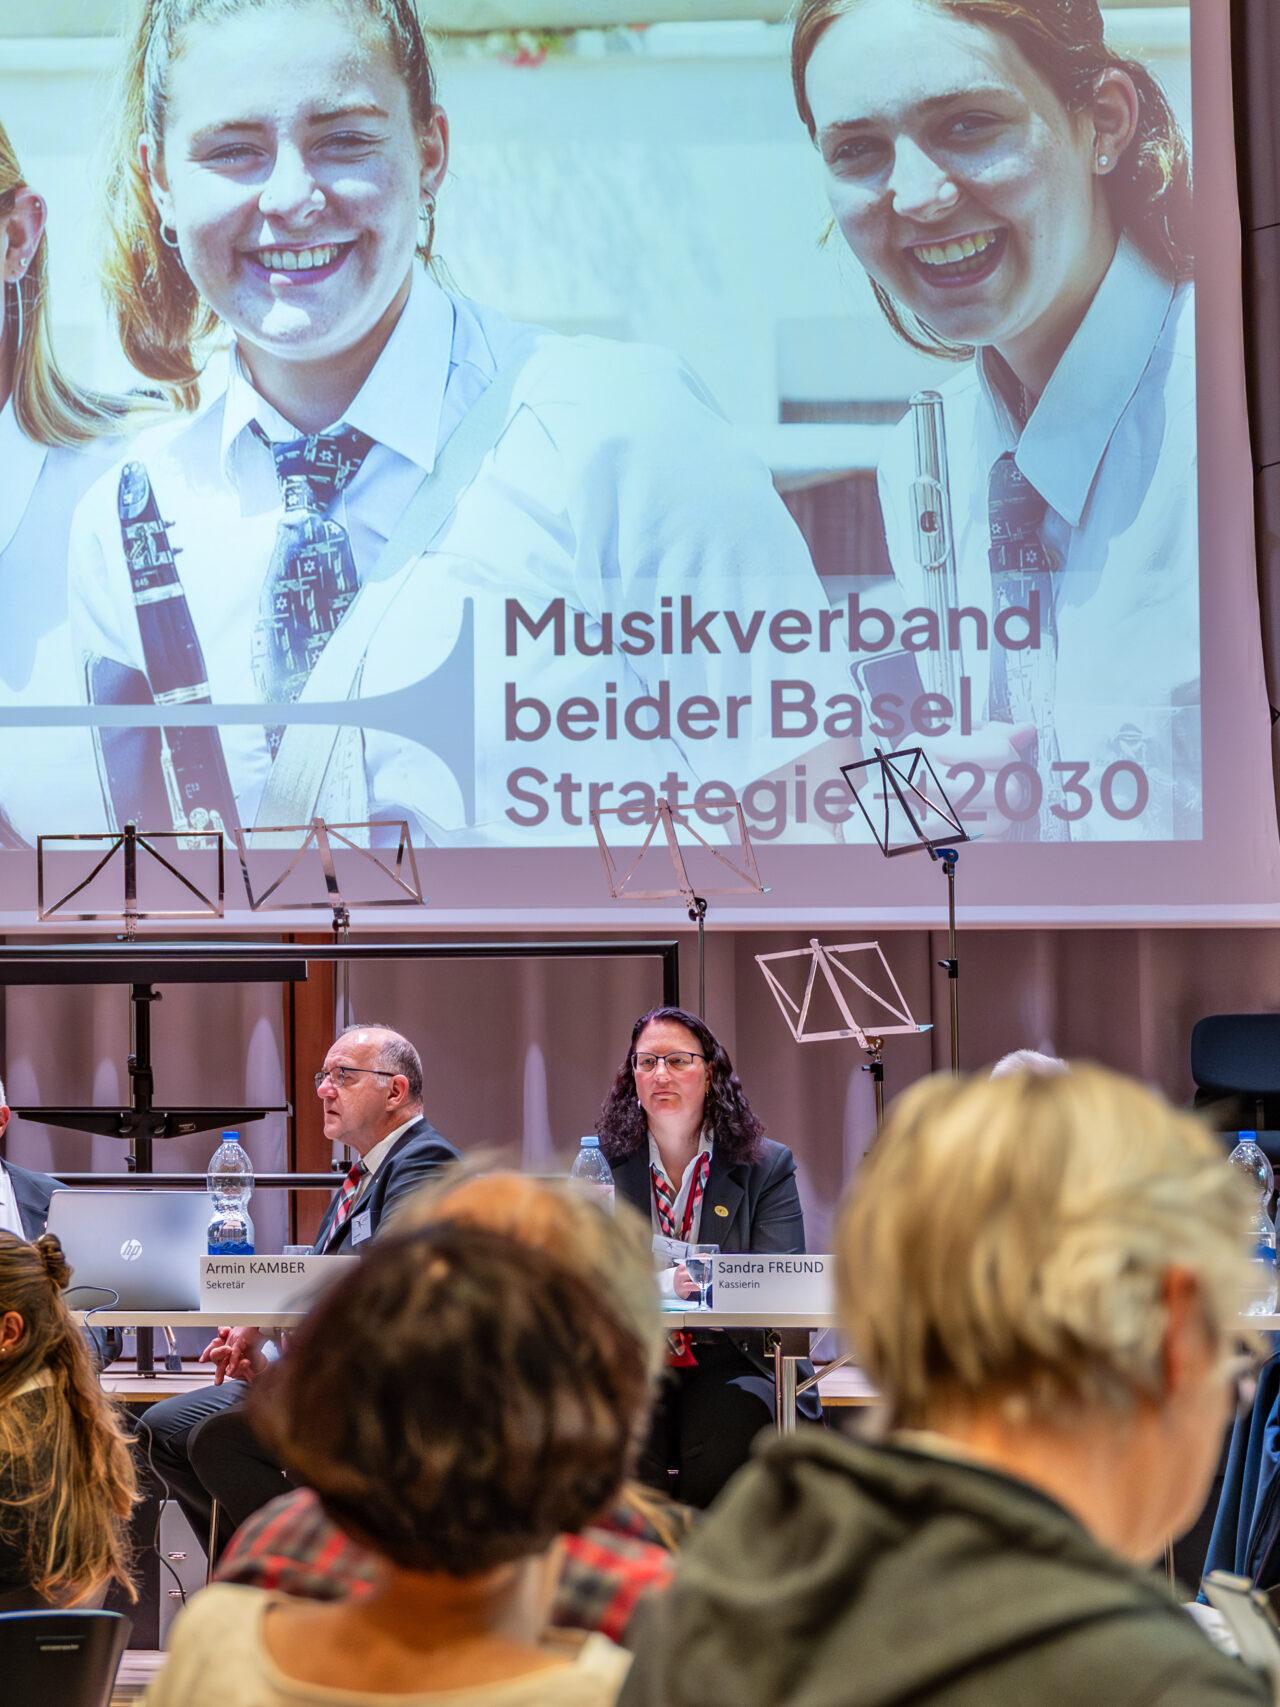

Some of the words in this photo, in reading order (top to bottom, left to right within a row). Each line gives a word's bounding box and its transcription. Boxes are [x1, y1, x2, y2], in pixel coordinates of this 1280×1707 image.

[505, 590, 1042, 656] Musikverband
[505, 680, 752, 742] beider
[770, 676, 972, 740] Basel
[505, 764, 857, 841] Strategie
[945, 760, 1149, 822] 2030
[206, 1262, 246, 1274] Armin
[249, 1262, 306, 1274] KAMBER
[718, 1261, 764, 1274] Sandra
[768, 1261, 824, 1274] FREUND
[206, 1280, 245, 1290] Sekretär
[719, 1280, 760, 1289] Kassierin
